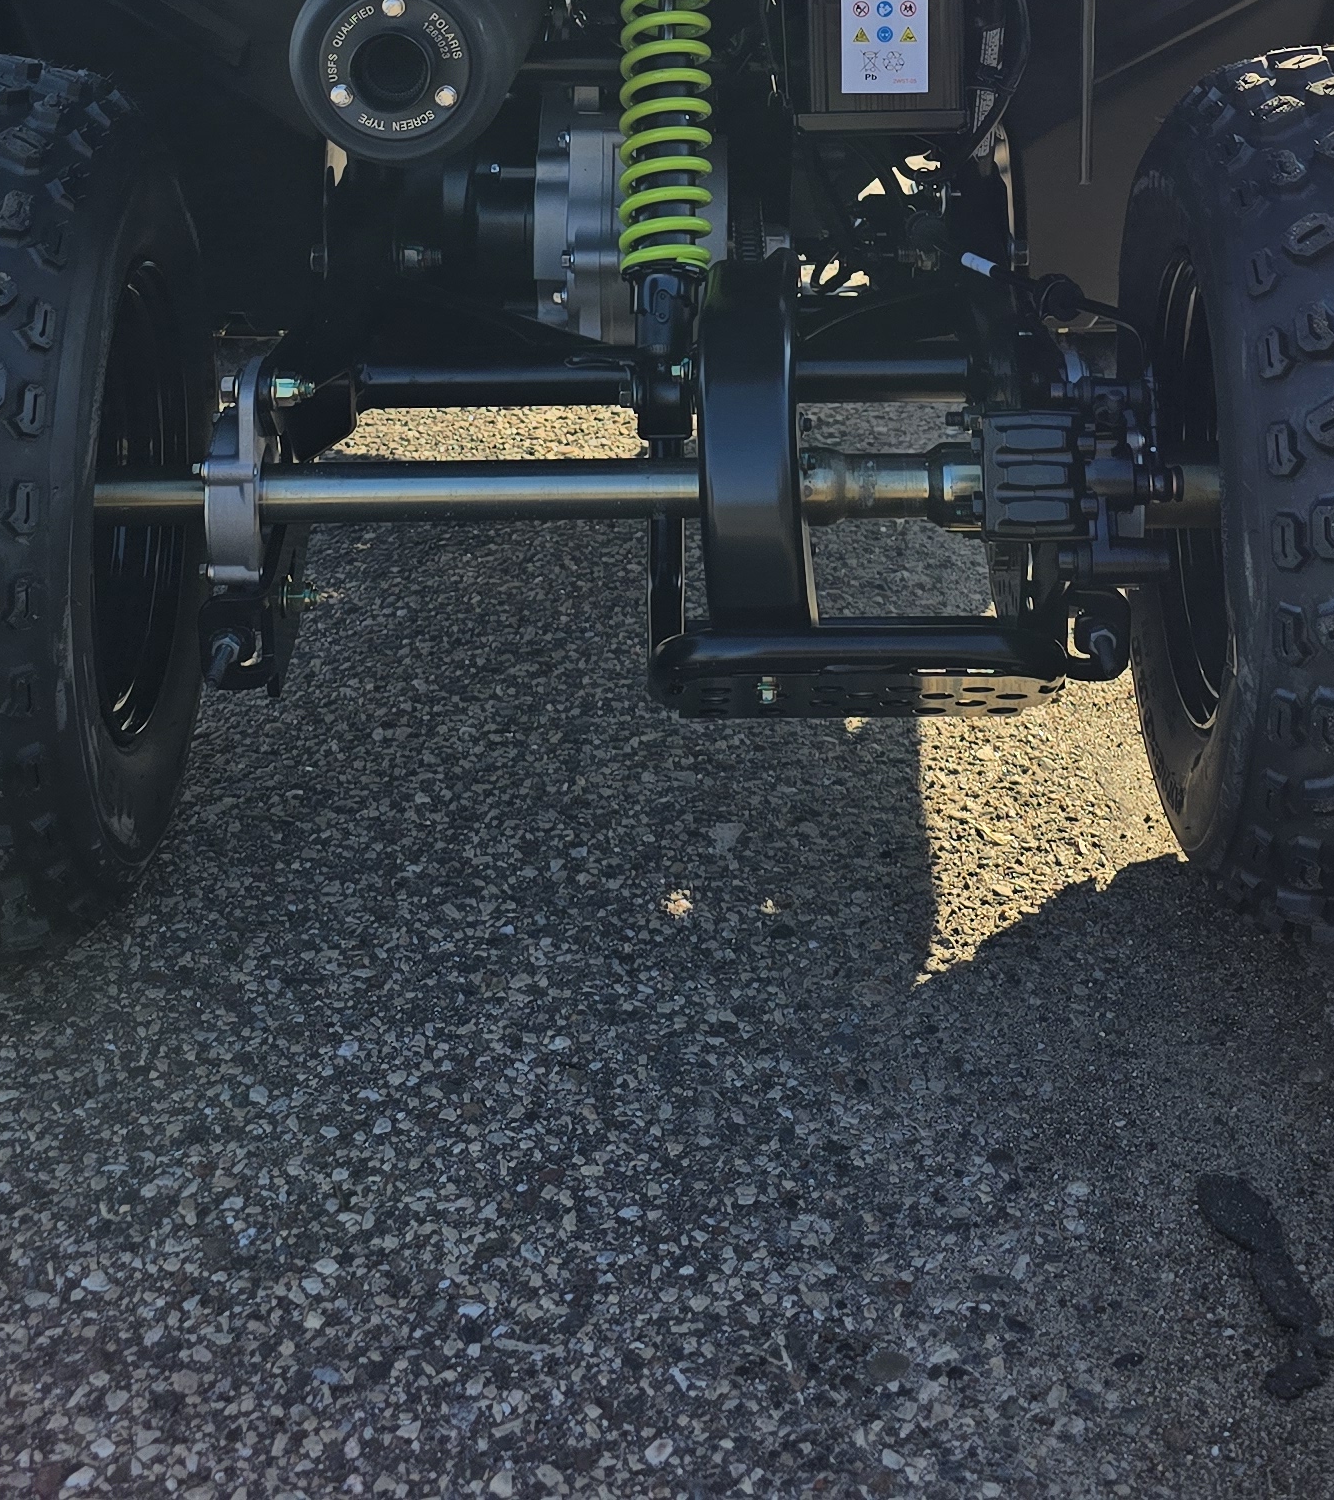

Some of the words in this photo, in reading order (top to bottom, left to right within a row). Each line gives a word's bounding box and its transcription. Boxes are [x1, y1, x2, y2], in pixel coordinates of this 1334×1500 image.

[332, 5, 375, 48] QUALIFIED
[428, 12, 463, 60] POLARIS
[327, 53, 338, 83] USFS
[865, 73, 878, 81] Pb
[358, 113, 385, 131] TYPE
[392, 110, 435, 131] SCREEN
